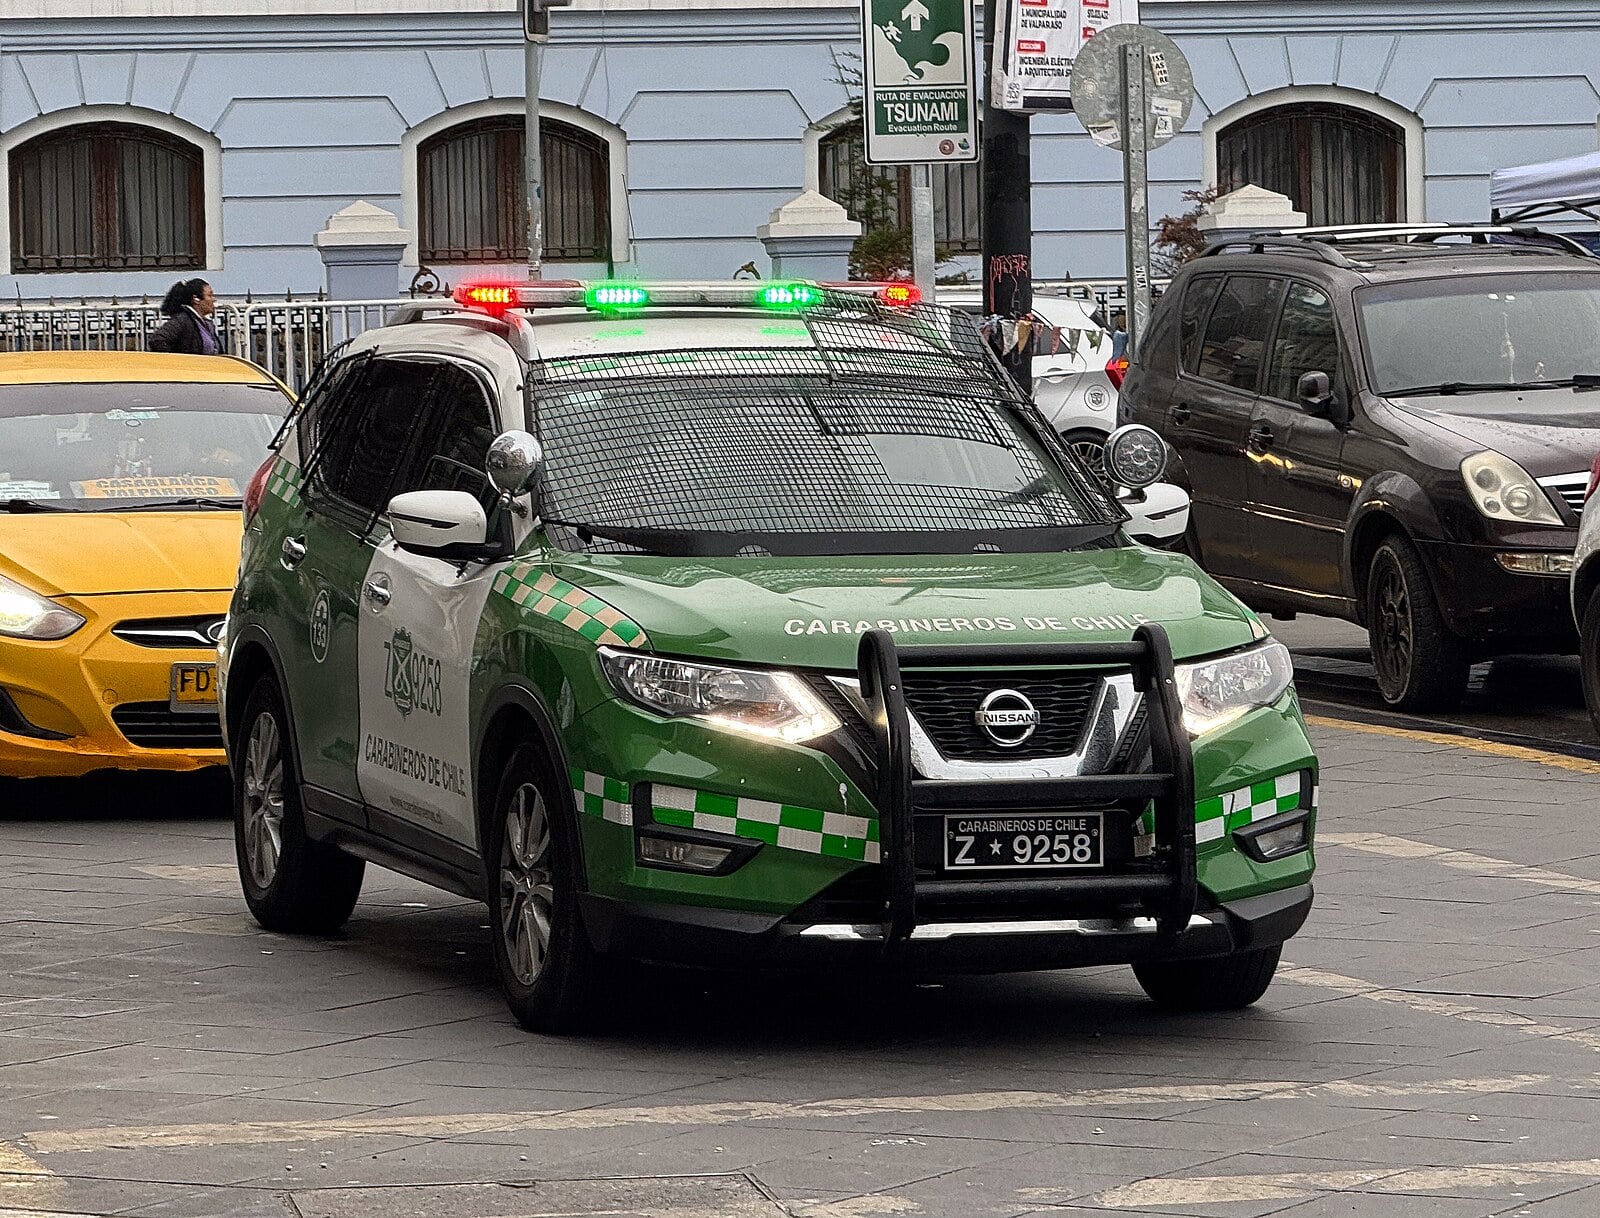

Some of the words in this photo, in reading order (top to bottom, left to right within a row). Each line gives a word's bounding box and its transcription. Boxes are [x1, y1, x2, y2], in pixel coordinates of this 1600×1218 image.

[1021, 19, 1028, 28] DE
[1050, 55, 1075, 67] ELÉCTRIC
[876, 92, 898, 101] RUTA
[900, 92, 911, 101] DE
[913, 89, 965, 101] EVACUACIÓN
[883, 102, 958, 122] TSUNAMI
[888, 123, 932, 133] Evacuation
[934, 123, 957, 131] Route
[96, 478, 220, 488] CASABLANCA
[103, 487, 219, 497] VALPARAISO
[783, 616, 1015, 636] CARABINEROS
[1022, 616, 1067, 632] DE
[1071, 614, 1148, 631] CHILE
[180, 669, 217, 692] FD
[412, 652, 441, 716] 9258
[983, 713, 1034, 723] NISSAN
[365, 733, 427, 782] CARABINEROS
[428, 755, 440, 787] DE
[442, 761, 467, 797] CHILE
[958, 820, 1036, 833] CARABINEROS
[1038, 820, 1052, 832] DE
[1055, 819, 1087, 832] CHILE
[955, 836, 976, 864] Z
[1013, 834, 1092, 863] 9258
